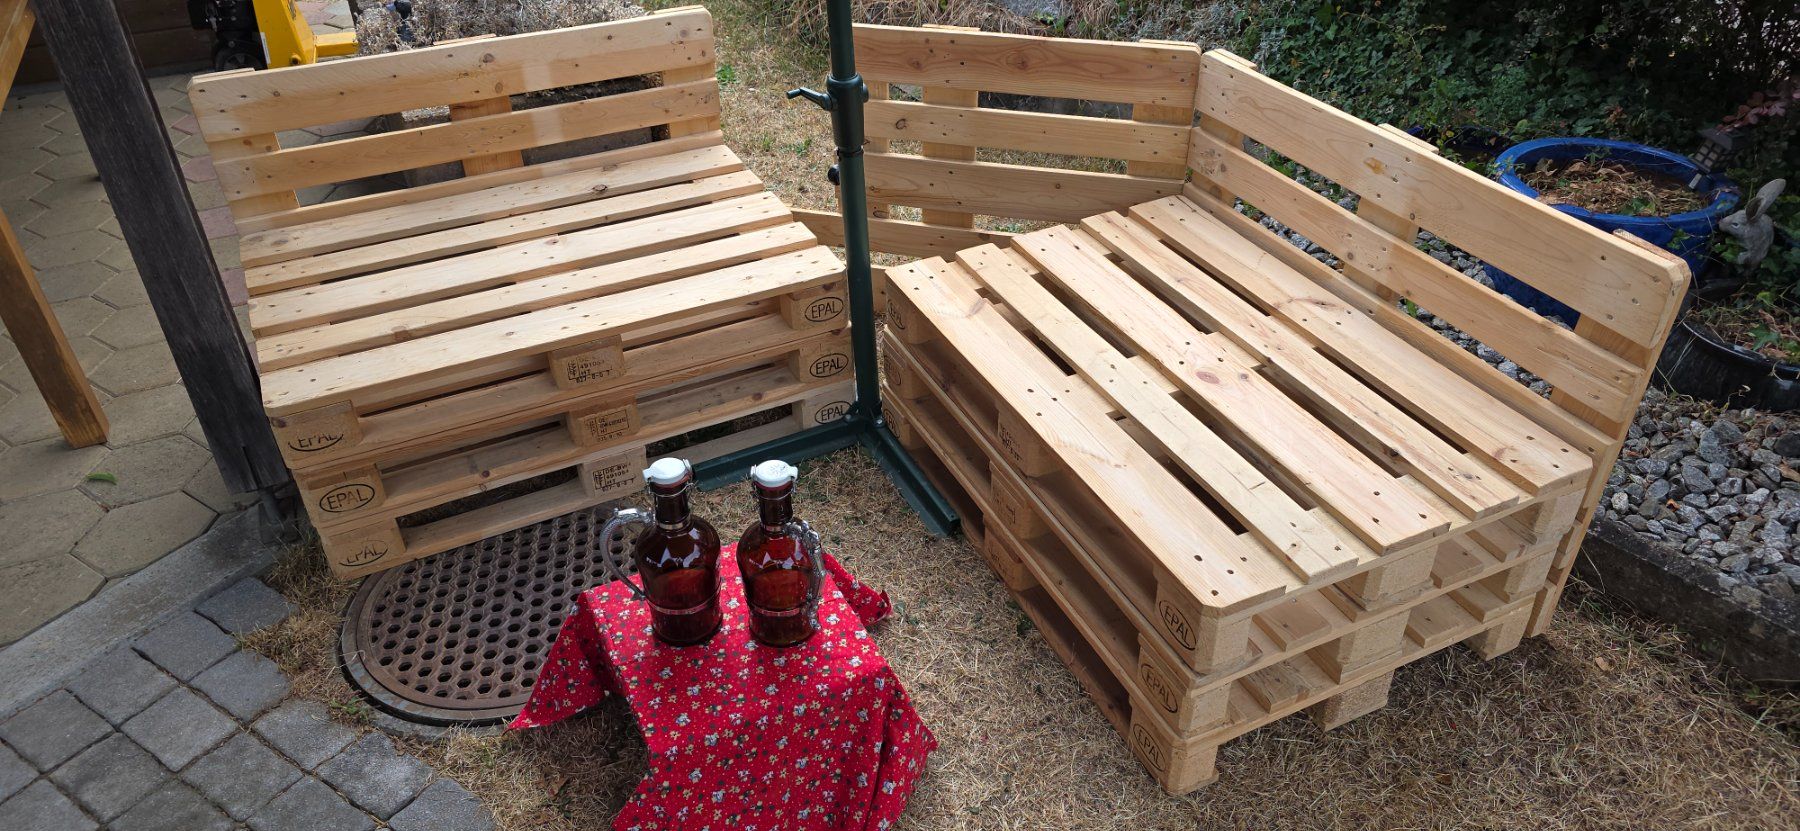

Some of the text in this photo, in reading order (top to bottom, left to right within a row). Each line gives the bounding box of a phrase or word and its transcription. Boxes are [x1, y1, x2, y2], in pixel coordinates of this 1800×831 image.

[811, 302, 838, 320] EPAL
[815, 356, 843, 375] EPAL
[820, 403, 845, 420] EPAL
[326, 488, 370, 510] EPAL
[1163, 607, 1191, 647] EPAL
[1146, 671, 1173, 710] EPAL
[1138, 729, 1162, 768] EPAL
